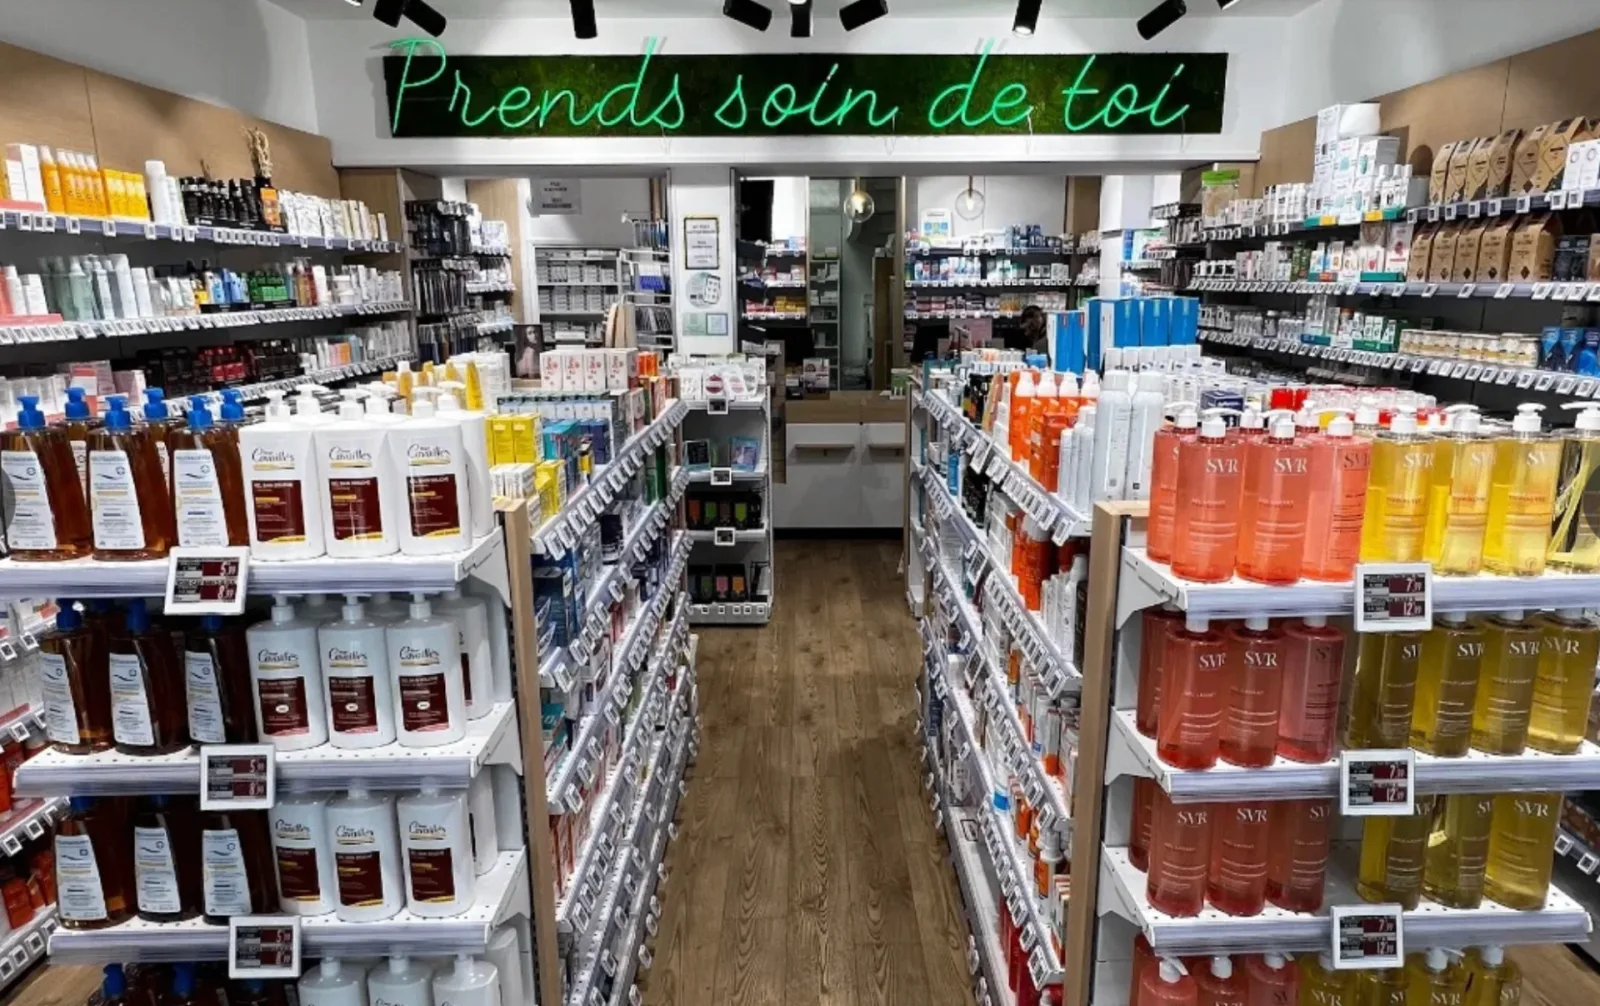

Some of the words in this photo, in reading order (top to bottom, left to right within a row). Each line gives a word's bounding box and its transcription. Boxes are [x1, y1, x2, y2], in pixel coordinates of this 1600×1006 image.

[390, 37, 686, 134] Prends
[713, 61, 898, 130] soin
[927, 38, 1033, 128] de
[1060, 54, 1189, 132] toi
[1206, 458, 1239, 473] SVR
[1273, 458, 1307, 473] SVR
[1244, 651, 1277, 667] SVR
[1236, 807, 1267, 822] SVR
[1514, 799, 1549, 817] SVR
[1177, 810, 1208, 825] SVR
